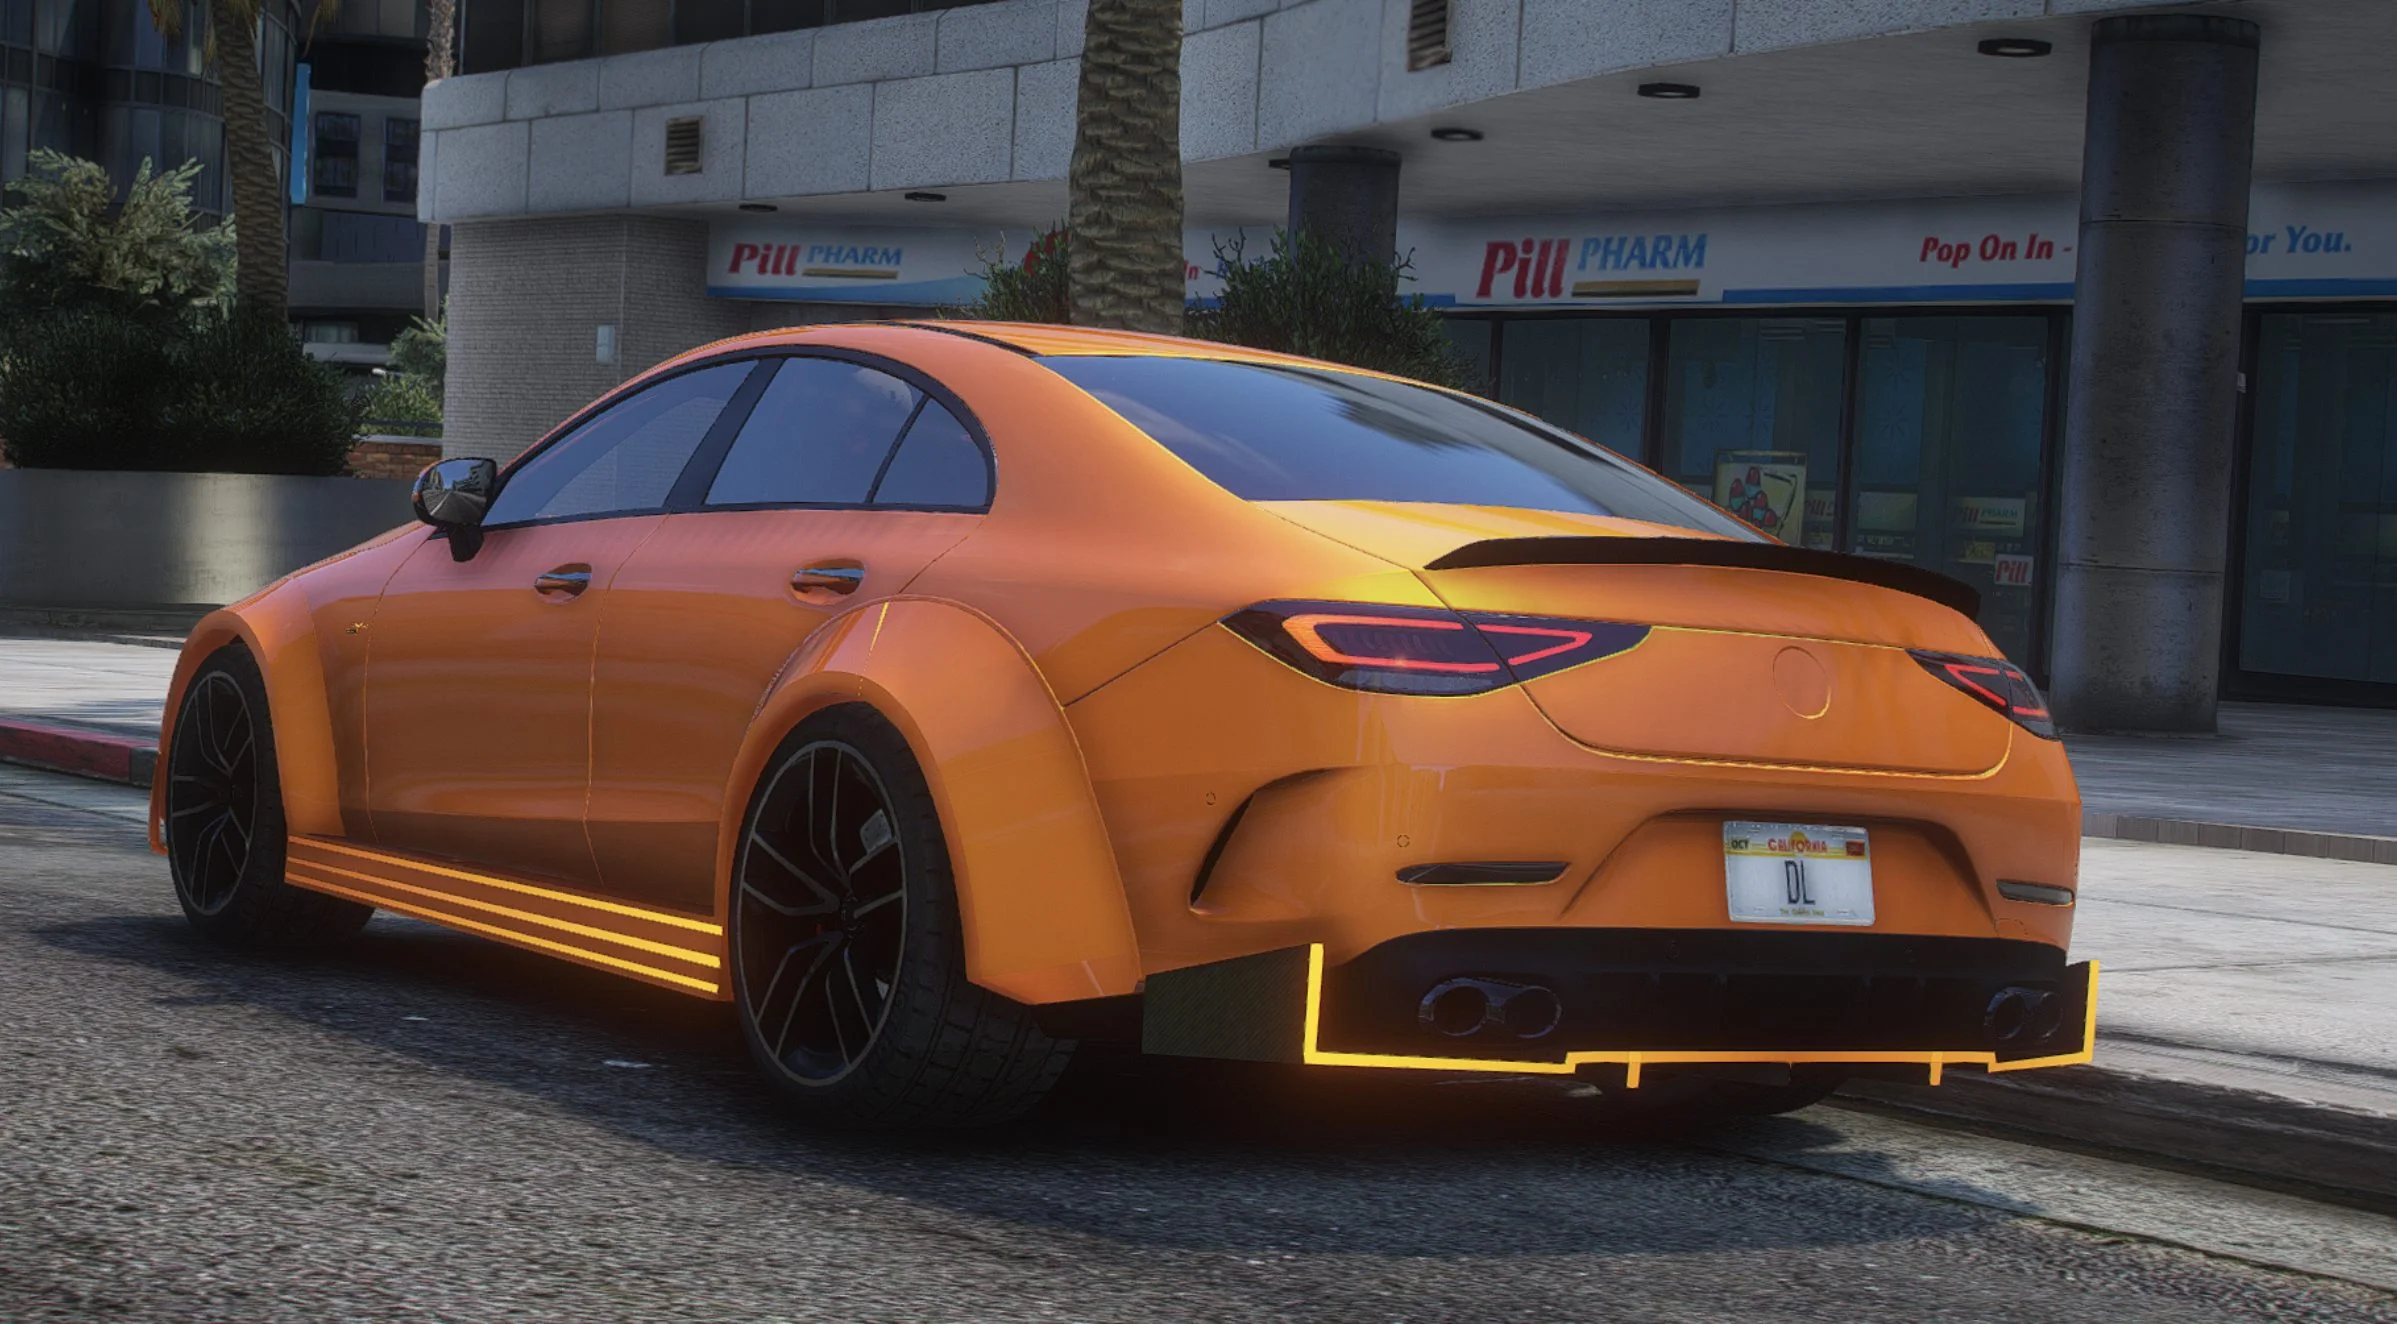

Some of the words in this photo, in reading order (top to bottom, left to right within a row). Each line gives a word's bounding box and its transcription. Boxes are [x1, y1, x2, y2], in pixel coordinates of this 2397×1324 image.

[1920, 236, 1971, 269] Pop
[1980, 234, 2017, 261] On
[2025, 233, 2054, 260] In
[2246, 233, 2276, 254] or
[2286, 225, 2352, 254] You.
[728, 243, 801, 276] Pill
[806, 245, 902, 266] PHARM
[1476, 238, 1571, 298] Pill
[1577, 233, 1708, 271] PHARM
[1995, 560, 2029, 583] Pill
[1731, 838, 1749, 850] OCT
[1768, 838, 1828, 853] CALIFORNIA
[1785, 860, 1816, 905] DL
